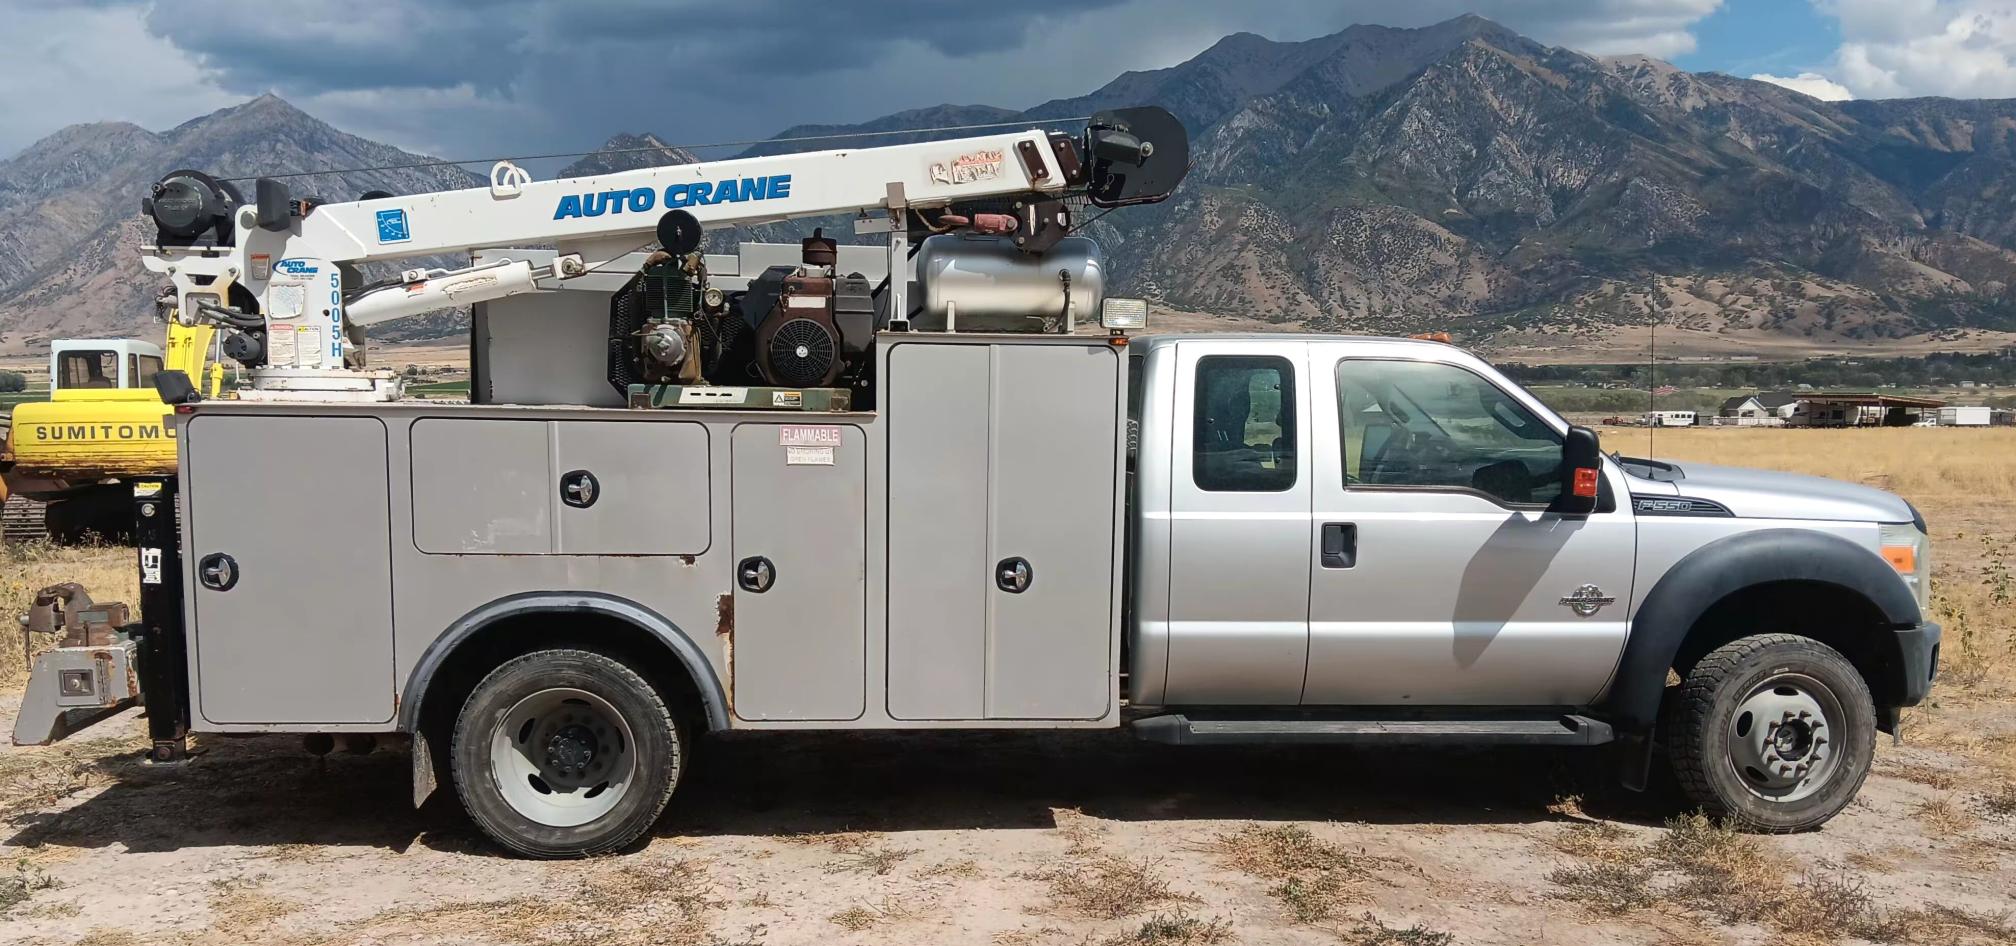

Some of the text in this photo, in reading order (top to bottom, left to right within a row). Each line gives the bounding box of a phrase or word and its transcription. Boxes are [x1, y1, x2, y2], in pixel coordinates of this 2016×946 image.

[553, 174, 792, 220] AUTO CRANE
[280, 260, 305, 268] AUTO
[330, 273, 342, 357] 5005H
[783, 428, 839, 441] FLAMMABLE
